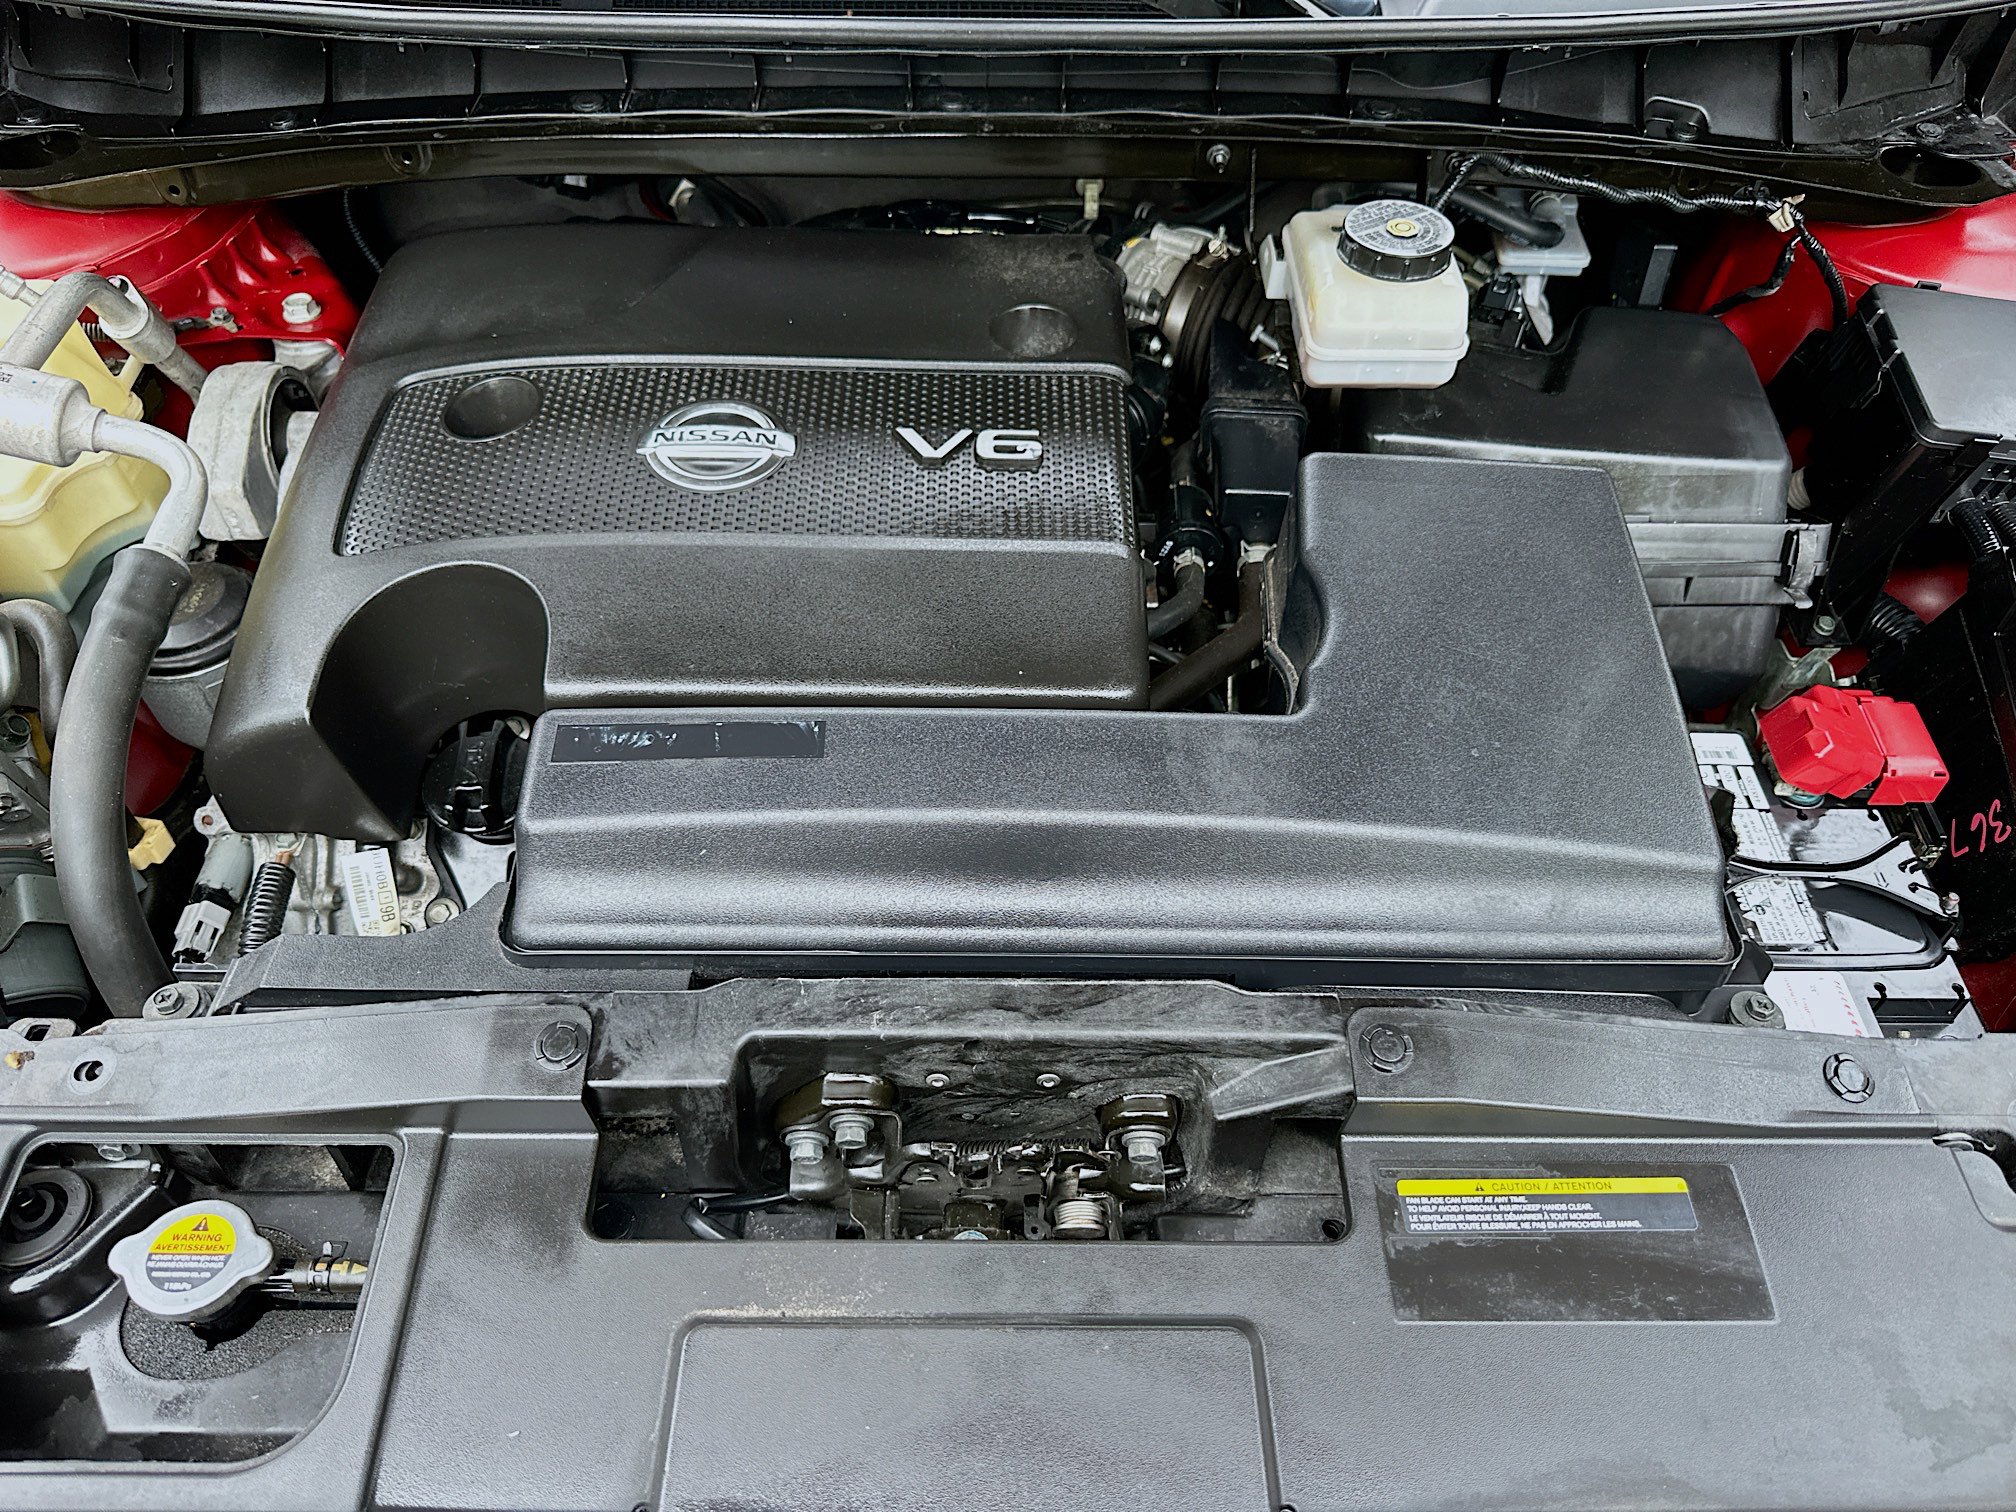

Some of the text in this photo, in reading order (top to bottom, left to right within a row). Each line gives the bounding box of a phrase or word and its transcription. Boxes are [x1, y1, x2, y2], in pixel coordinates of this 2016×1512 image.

[654, 427, 1043, 465] NISSAN V6
[380, 905, 396, 922] 9B
[1491, 1182, 1541, 1192] CAUTION
[1553, 1181, 1613, 1191] ATTENTION
[1405, 1196, 1420, 1204] FAN
[1420, 1196, 1445, 1204] BLADE
[1445, 1196, 1461, 1204] CAN
[1461, 1196, 1483, 1204] START
[1406, 1205, 1418, 1213] TO
[1418, 1204, 1438, 1213] HELP
[1437, 1204, 1460, 1212] AVOID
[1460, 1204, 1499, 1212] PERSONAL
[1541, 1203, 1568, 1211] HANDS
[1408, 1214, 1419, 1222] LE
[1492, 1213, 1504, 1221] DE
[1410, 1222, 1432, 1231] POUR
[1456, 1222, 1481, 1230] TOUTE
[1520, 1221, 1532, 1229] NE
[1531, 1221, 1547, 1229] PAS
[1546, 1221, 1558, 1229] EN
[1602, 1220, 1617, 1228] LES
[172, 1233, 223, 1242] WARNING
